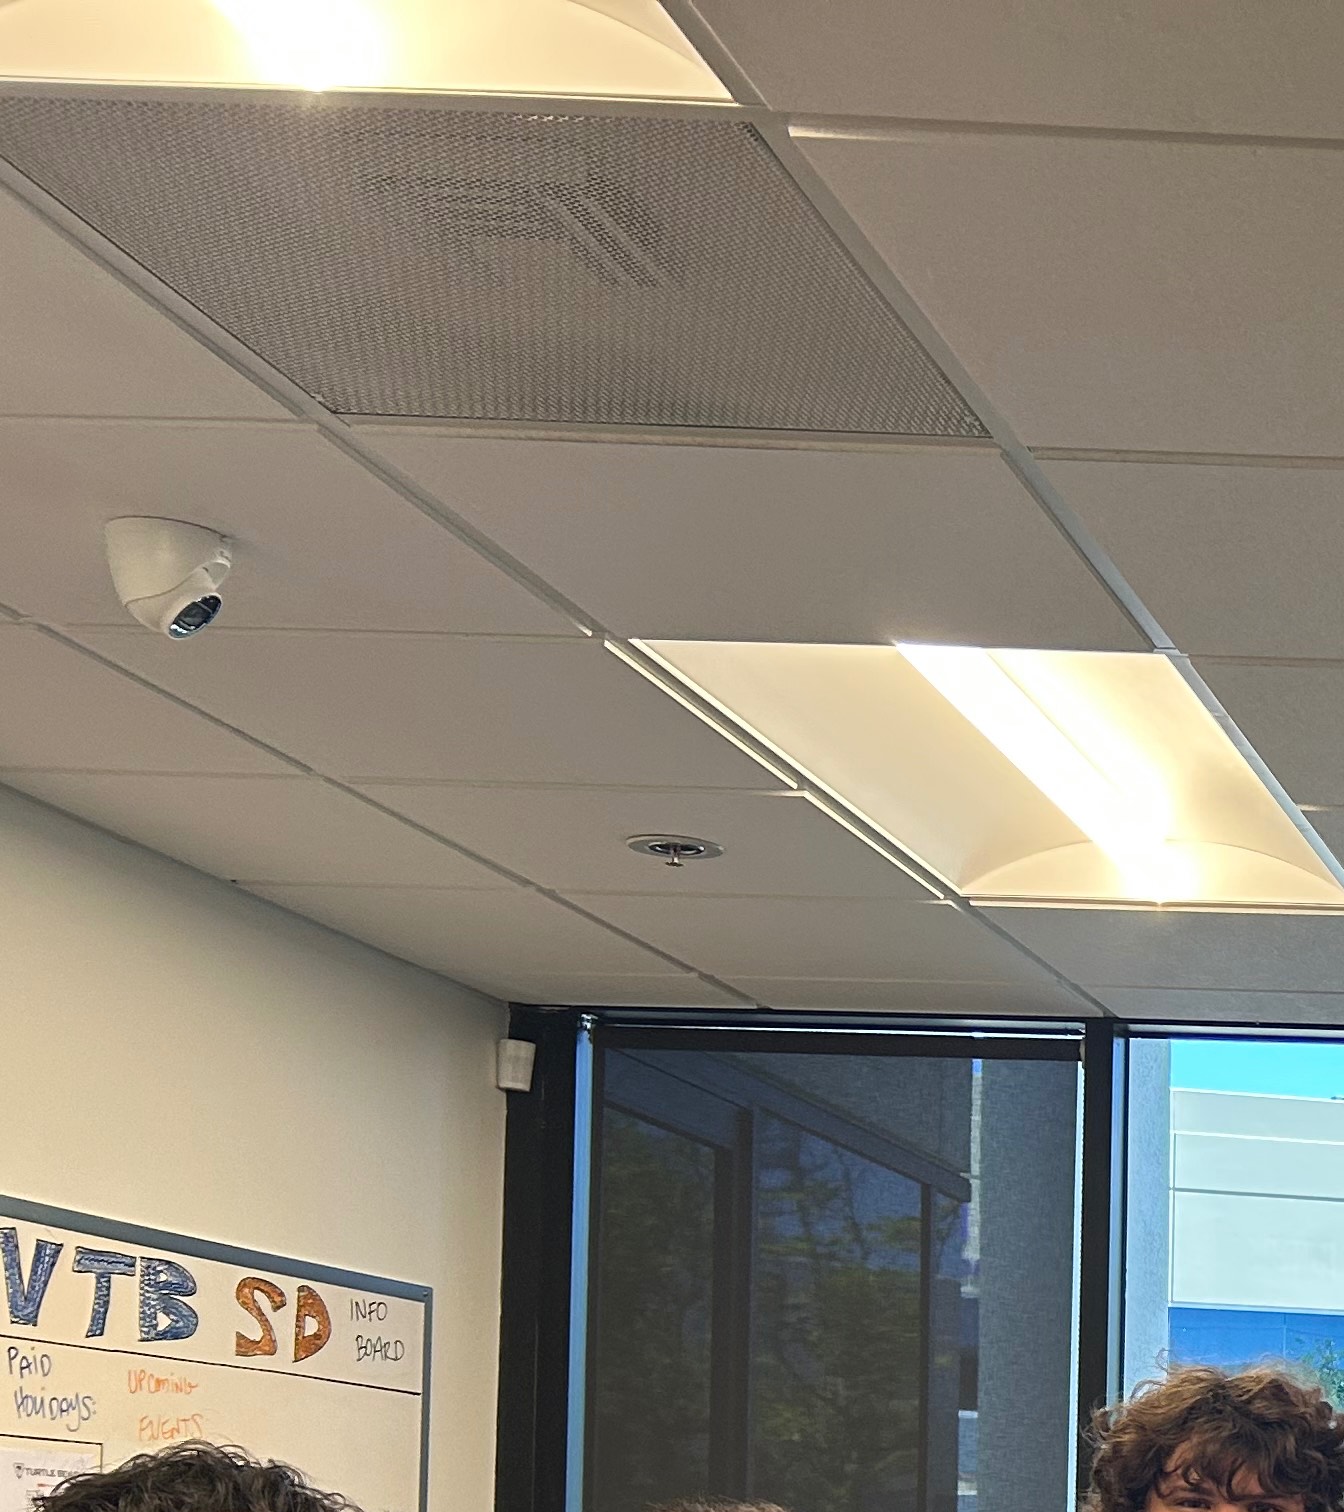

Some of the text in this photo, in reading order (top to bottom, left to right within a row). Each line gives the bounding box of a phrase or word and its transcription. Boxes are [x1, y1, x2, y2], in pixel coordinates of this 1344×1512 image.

[0, 1226, 332, 1363] VTB SD
[350, 1299, 388, 1323] INFO
[355, 1334, 406, 1362] BOARD
[138, 1412, 204, 1441] EVENTS
